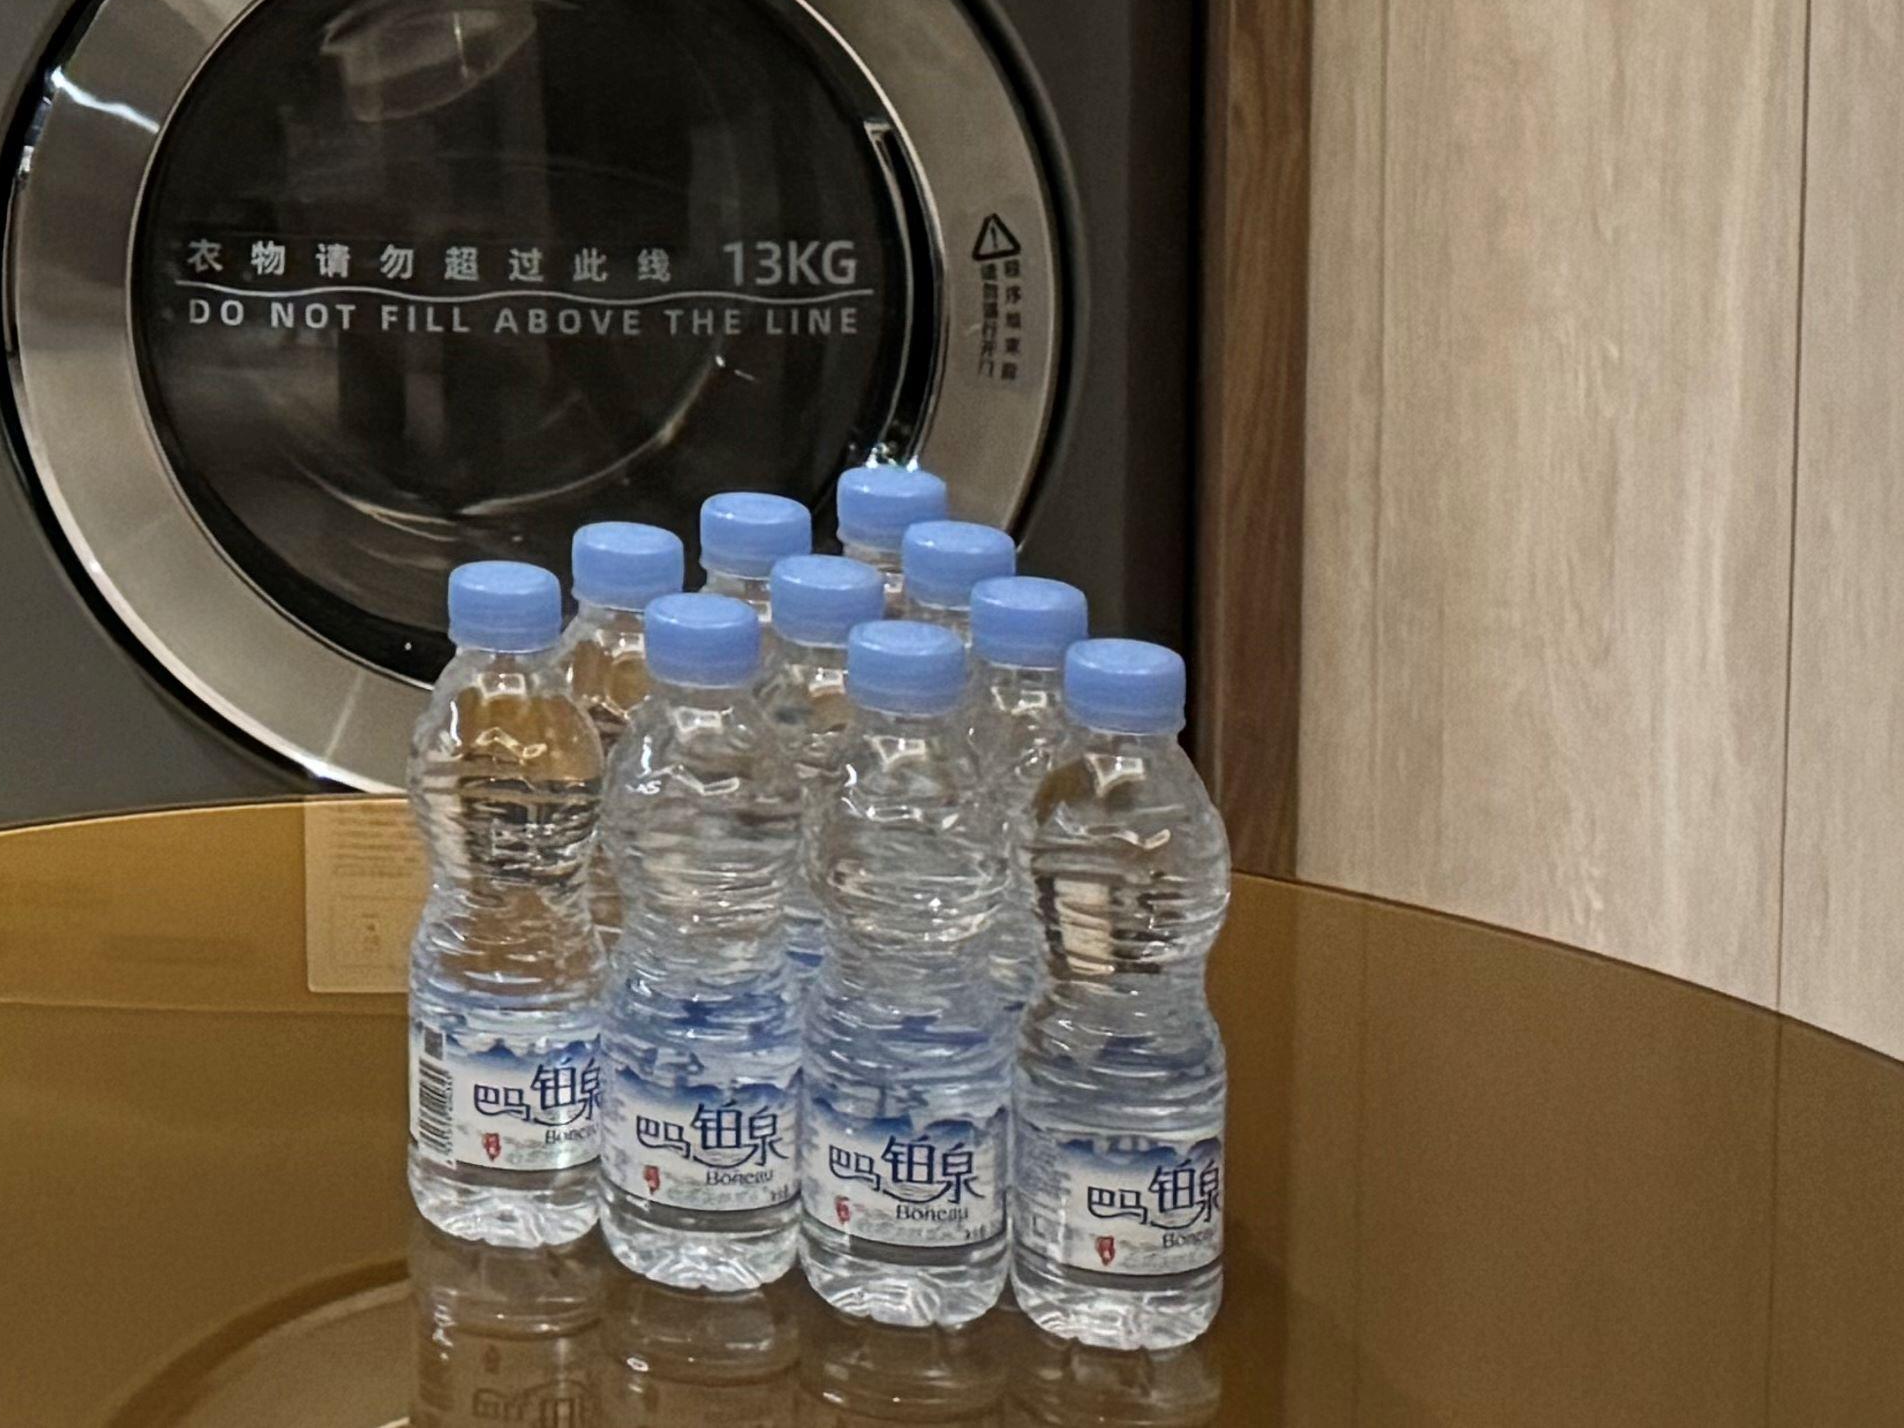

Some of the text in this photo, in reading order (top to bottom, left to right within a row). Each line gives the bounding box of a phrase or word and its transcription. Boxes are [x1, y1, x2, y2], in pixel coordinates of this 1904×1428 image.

[189, 241, 856, 285] 衣物请勿超过此线 13KG
[191, 300, 856, 334] DO NOT FILL ABOVE THE LINE
